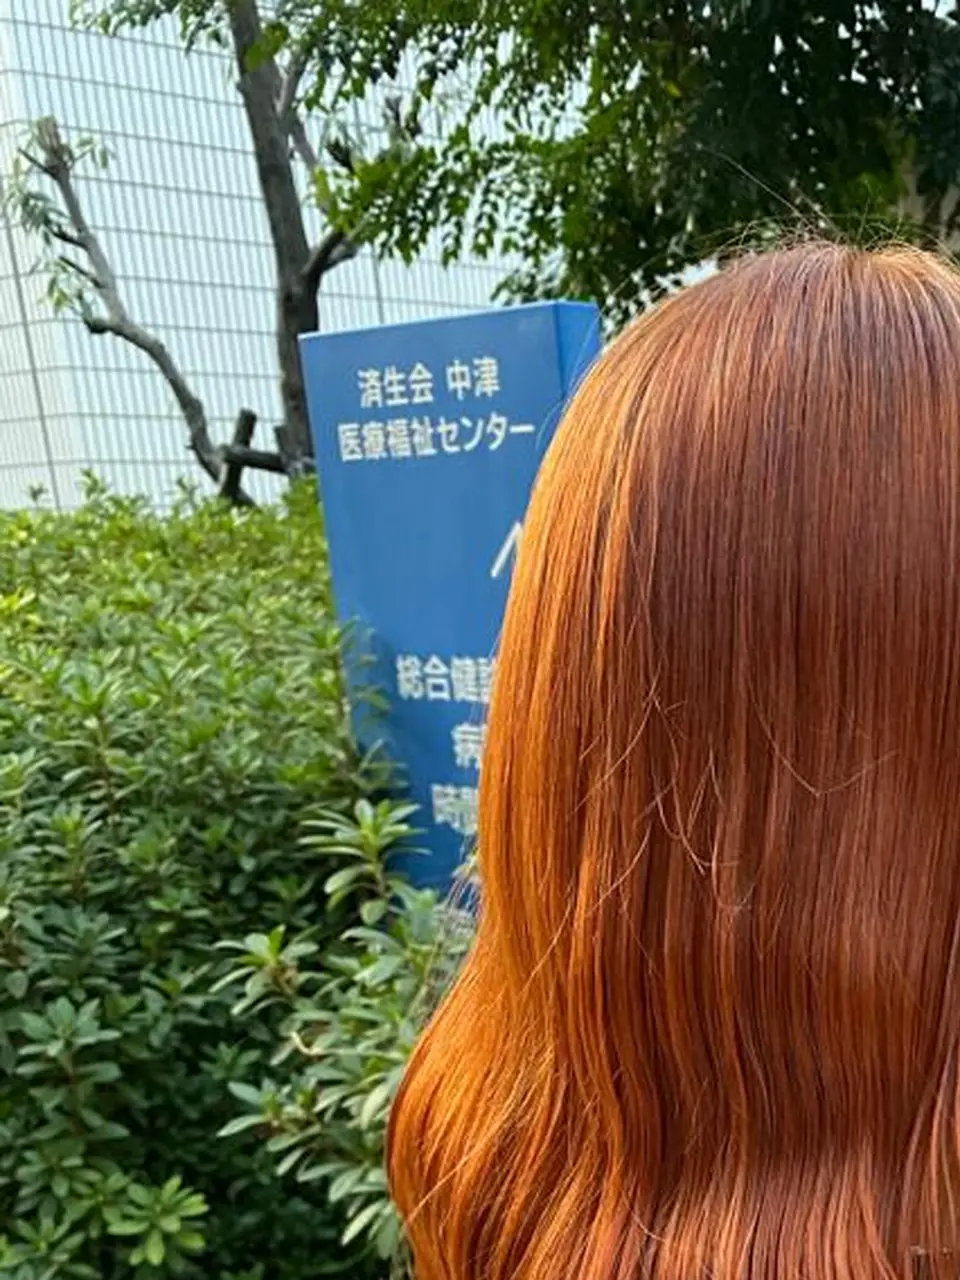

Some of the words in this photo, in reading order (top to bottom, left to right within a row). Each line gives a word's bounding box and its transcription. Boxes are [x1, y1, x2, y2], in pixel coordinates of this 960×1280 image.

[357, 362, 434, 409] 済生会
[446, 356, 501, 401] 中津
[337, 411, 535, 462] 医療福祉センター
